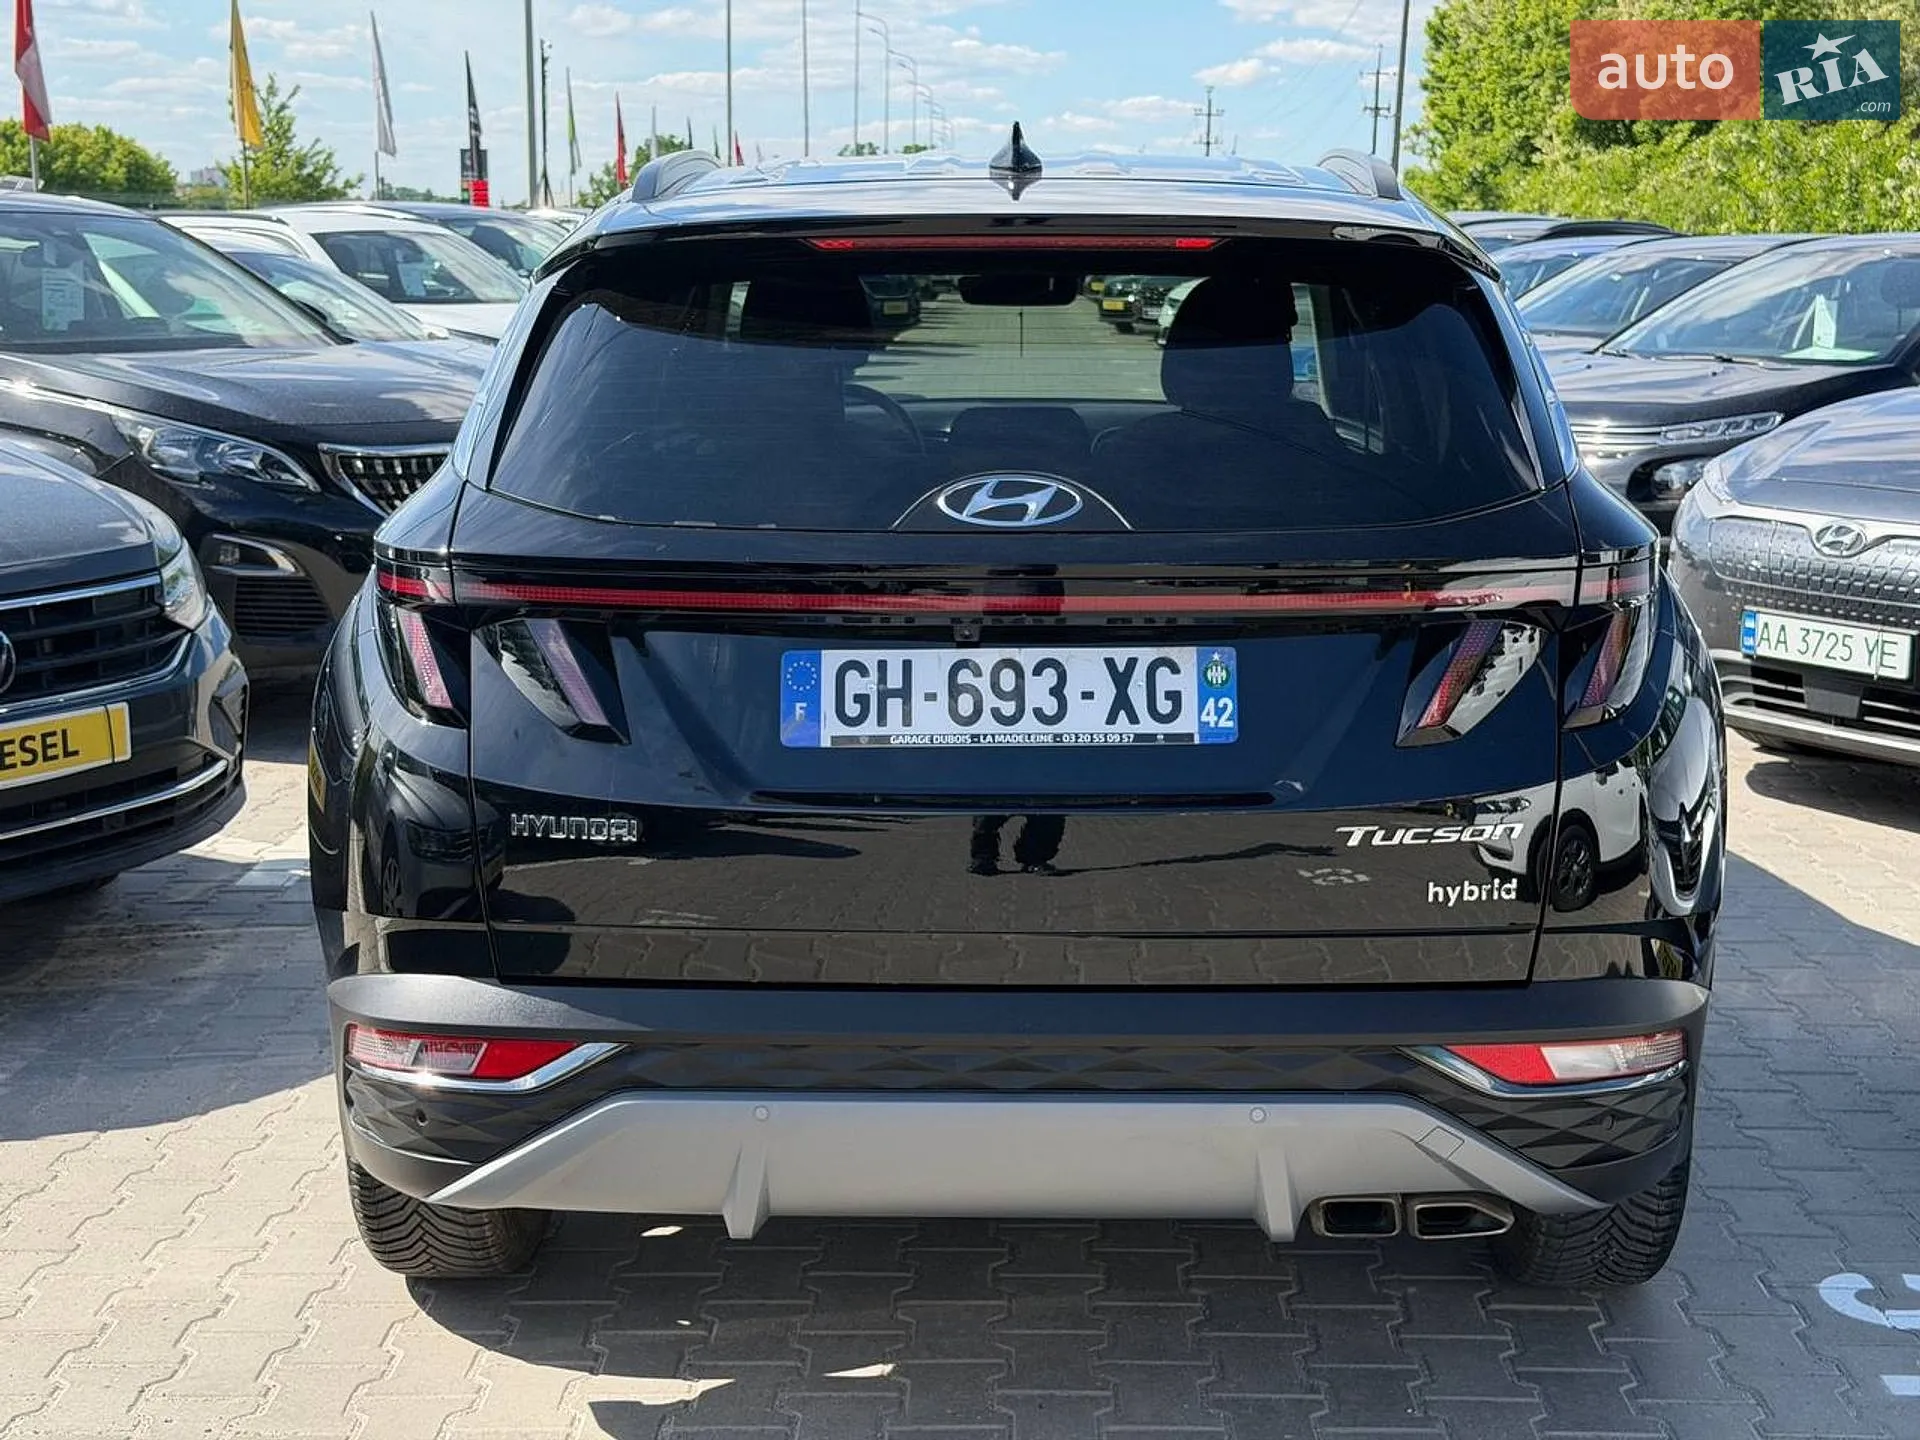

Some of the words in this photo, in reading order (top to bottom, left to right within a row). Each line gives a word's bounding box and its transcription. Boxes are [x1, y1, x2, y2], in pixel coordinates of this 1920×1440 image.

[1757, 622, 1789, 653] AA
[1798, 627, 1855, 662] 3725
[1865, 636, 1899, 670] YE
[835, 656, 1182, 727] GH-693-XG
[1200, 696, 1235, 728] 42
[890, 735, 931, 745] GARAGE
[933, 734, 972, 744] DUBOIS
[980, 734, 993, 744] LA
[995, 734, 1054, 744] MADELEINE
[1062, 733, 1076, 743] 03
[1077, 733, 1091, 743] 20
[1093, 733, 1106, 743] 55
[1122, 733, 1135, 743] 57
[511, 813, 638, 842] HYUNDAI
[1427, 877, 1518, 907] hybrid
